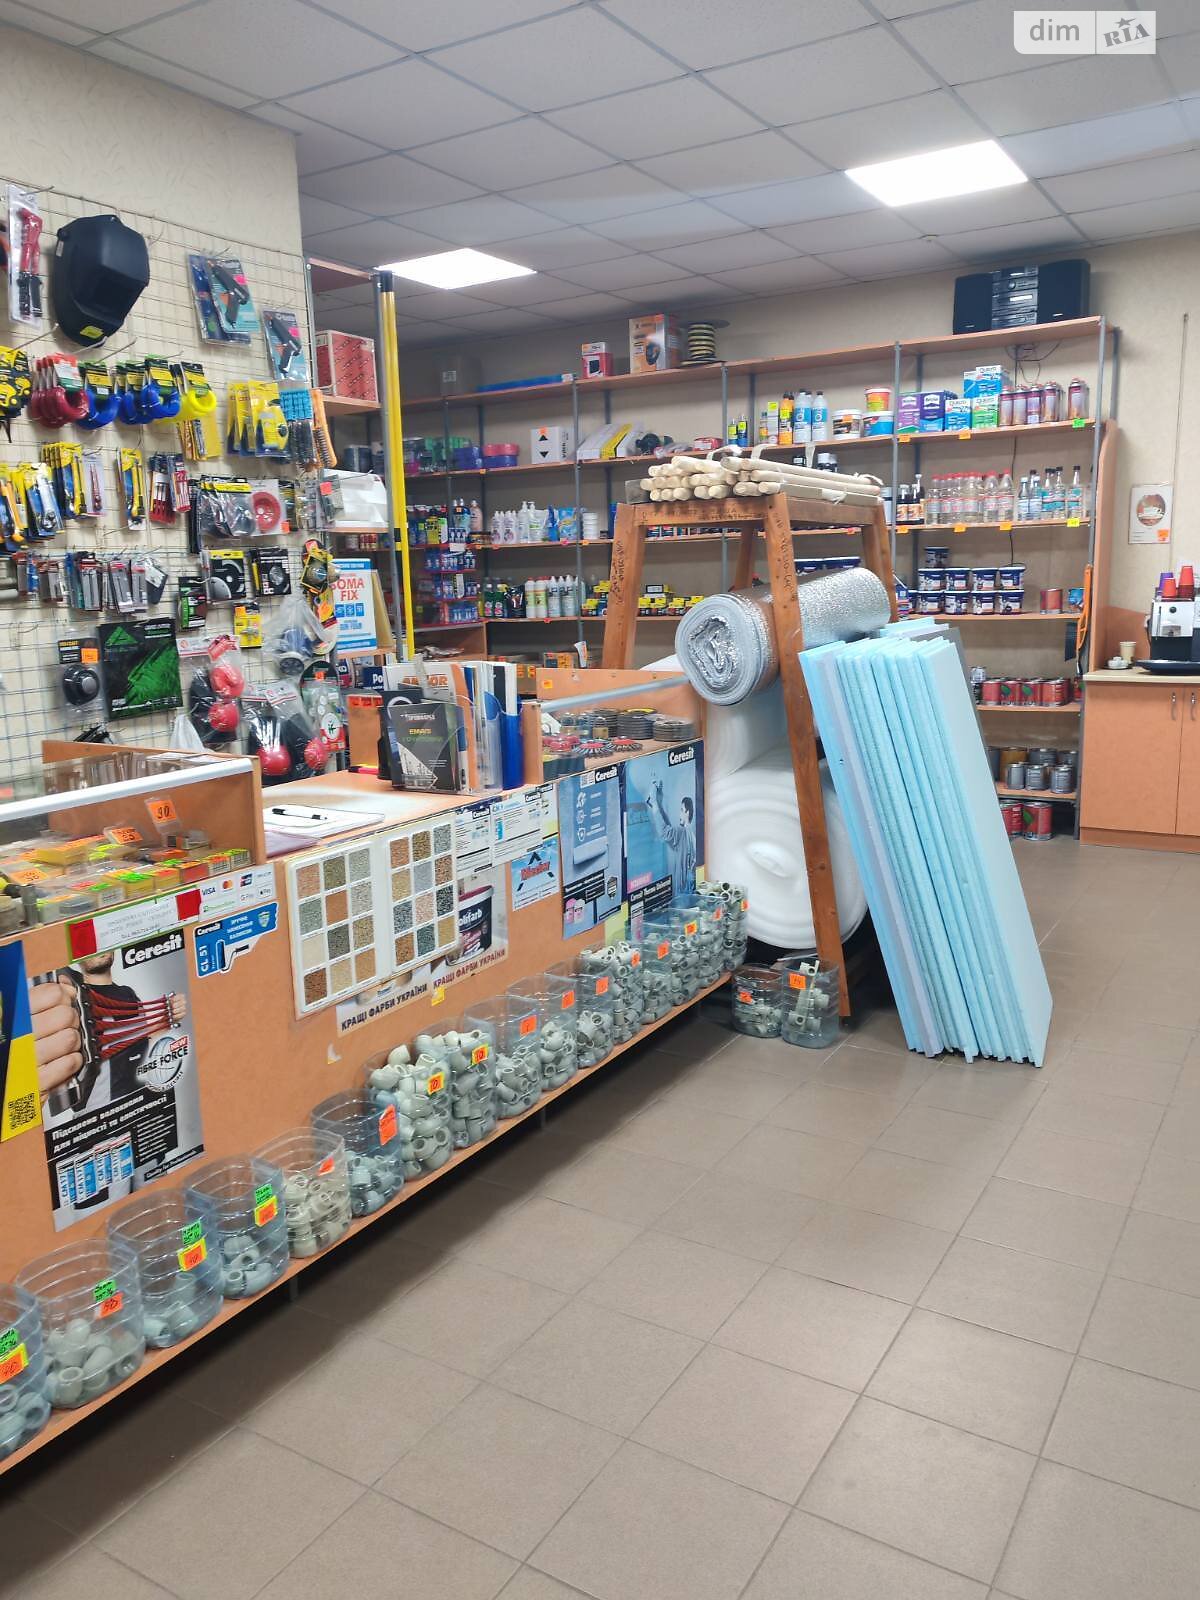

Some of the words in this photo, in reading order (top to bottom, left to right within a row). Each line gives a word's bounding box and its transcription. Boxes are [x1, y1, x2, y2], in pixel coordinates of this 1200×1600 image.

[340, 590, 359, 601] FIX
[669, 747, 695, 765] Ceresit
[595, 766, 618, 782] Ceresit
[202, 887, 216, 896] VISA
[458, 907, 482, 927] olifarb
[197, 922, 221, 936] Ceresit
[124, 934, 183, 966] Ceresit
[201, 958, 209, 972] CL
[433, 973, 455, 989] КРАЩІ
[455, 961, 479, 978] ФАРБИ
[479, 948, 506, 968] УКРАЇНИ
[341, 1012, 368, 1032] КРАЩІ
[368, 997, 396, 1018] ФАРБИ
[396, 983, 428, 1005] УКРАЇНИ
[137, 1059, 158, 1076] FIBRE
[159, 1045, 188, 1066] FORCE
